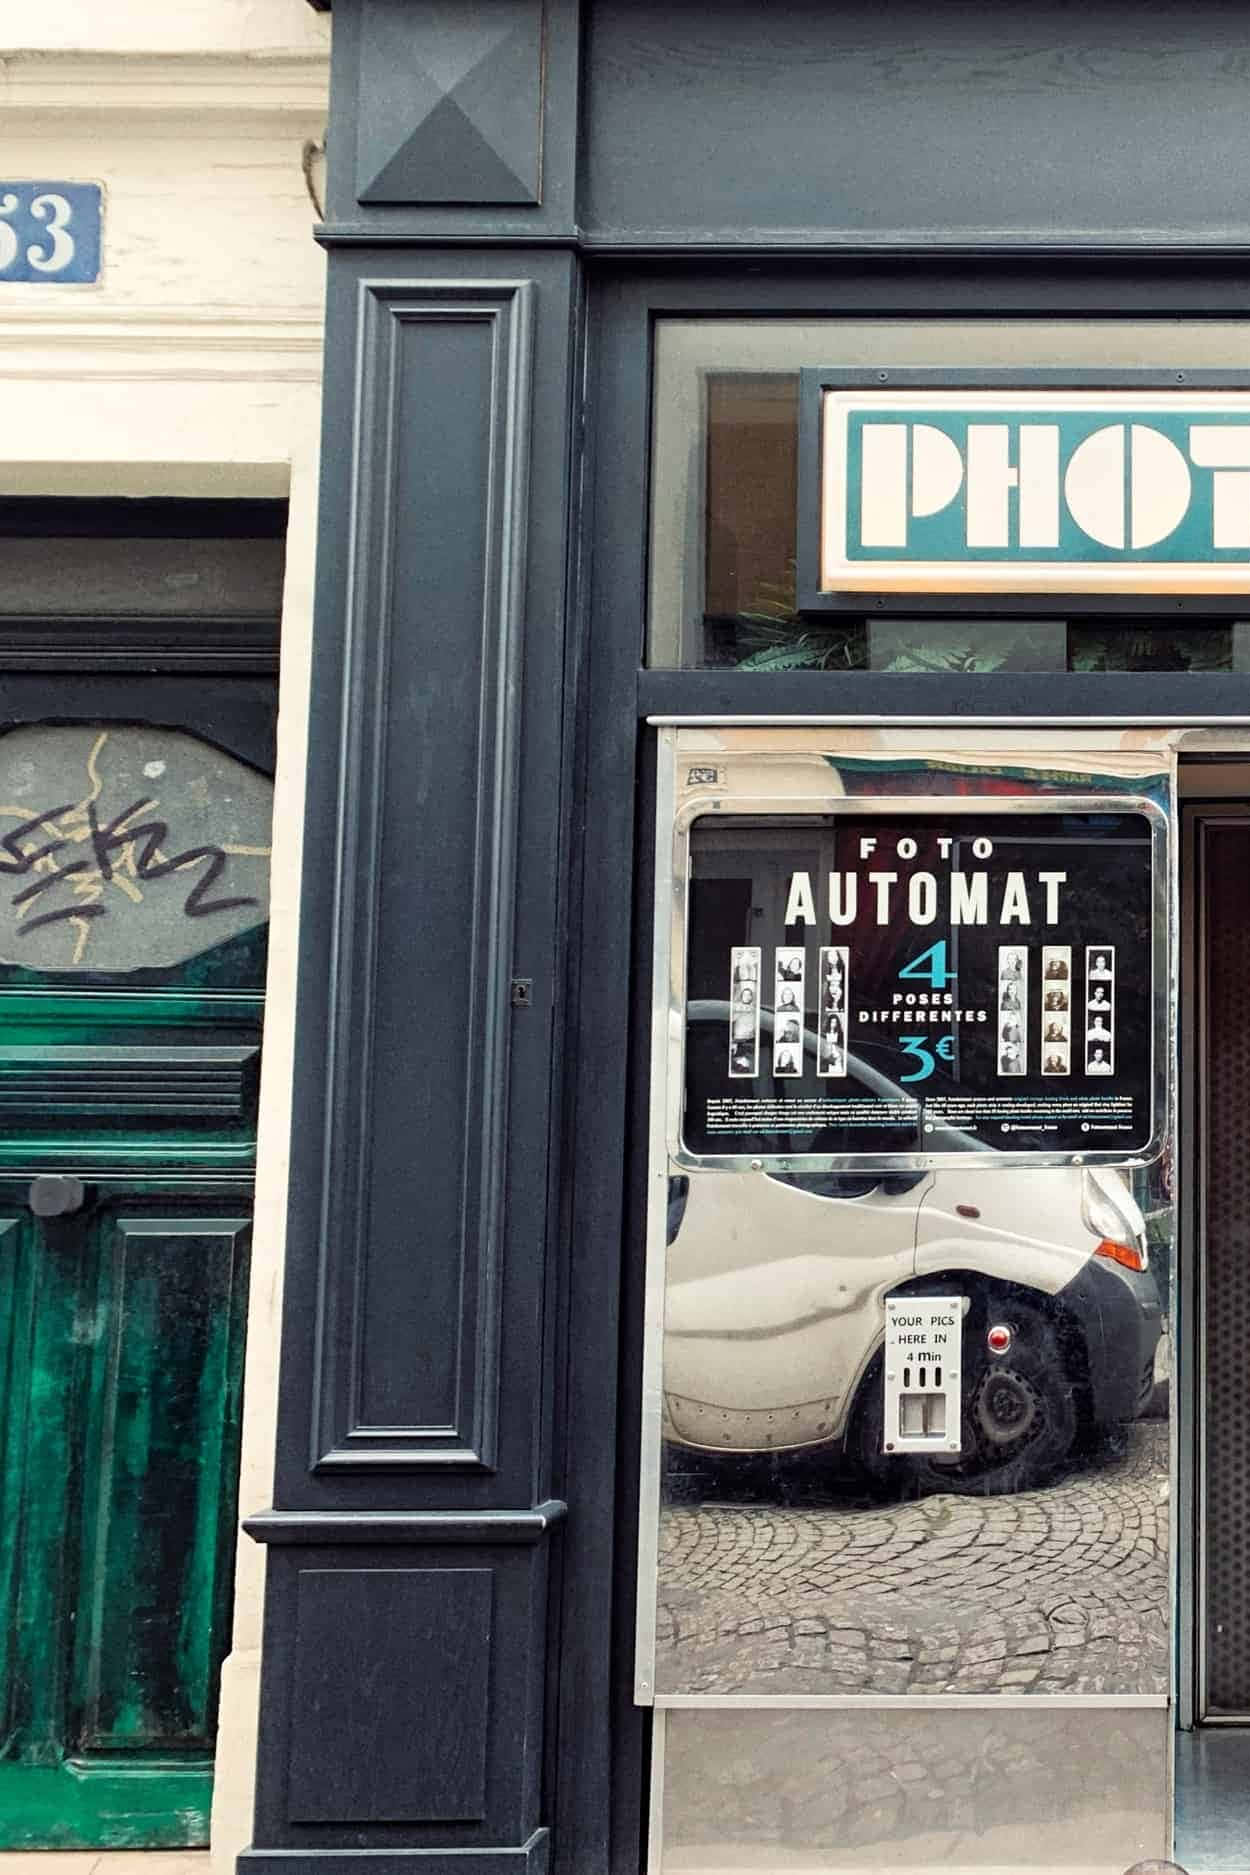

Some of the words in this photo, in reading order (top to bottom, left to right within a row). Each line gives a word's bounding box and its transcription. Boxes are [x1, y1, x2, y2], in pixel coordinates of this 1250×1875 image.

[859, 837, 993, 859] FOTO
[784, 871, 1067, 925] AUTOMAT
[899, 940, 958, 988] 4
[892, 993, 953, 1005] POSES
[858, 1010, 988, 1023] DIFFERENTES
[891, 1317, 923, 1326] YOUR
[930, 1316, 955, 1326] PICS
[898, 1334, 927, 1344] HERE
[934, 1334, 947, 1344] IN
[906, 1352, 914, 1361] 4
[918, 1351, 942, 1361] min
